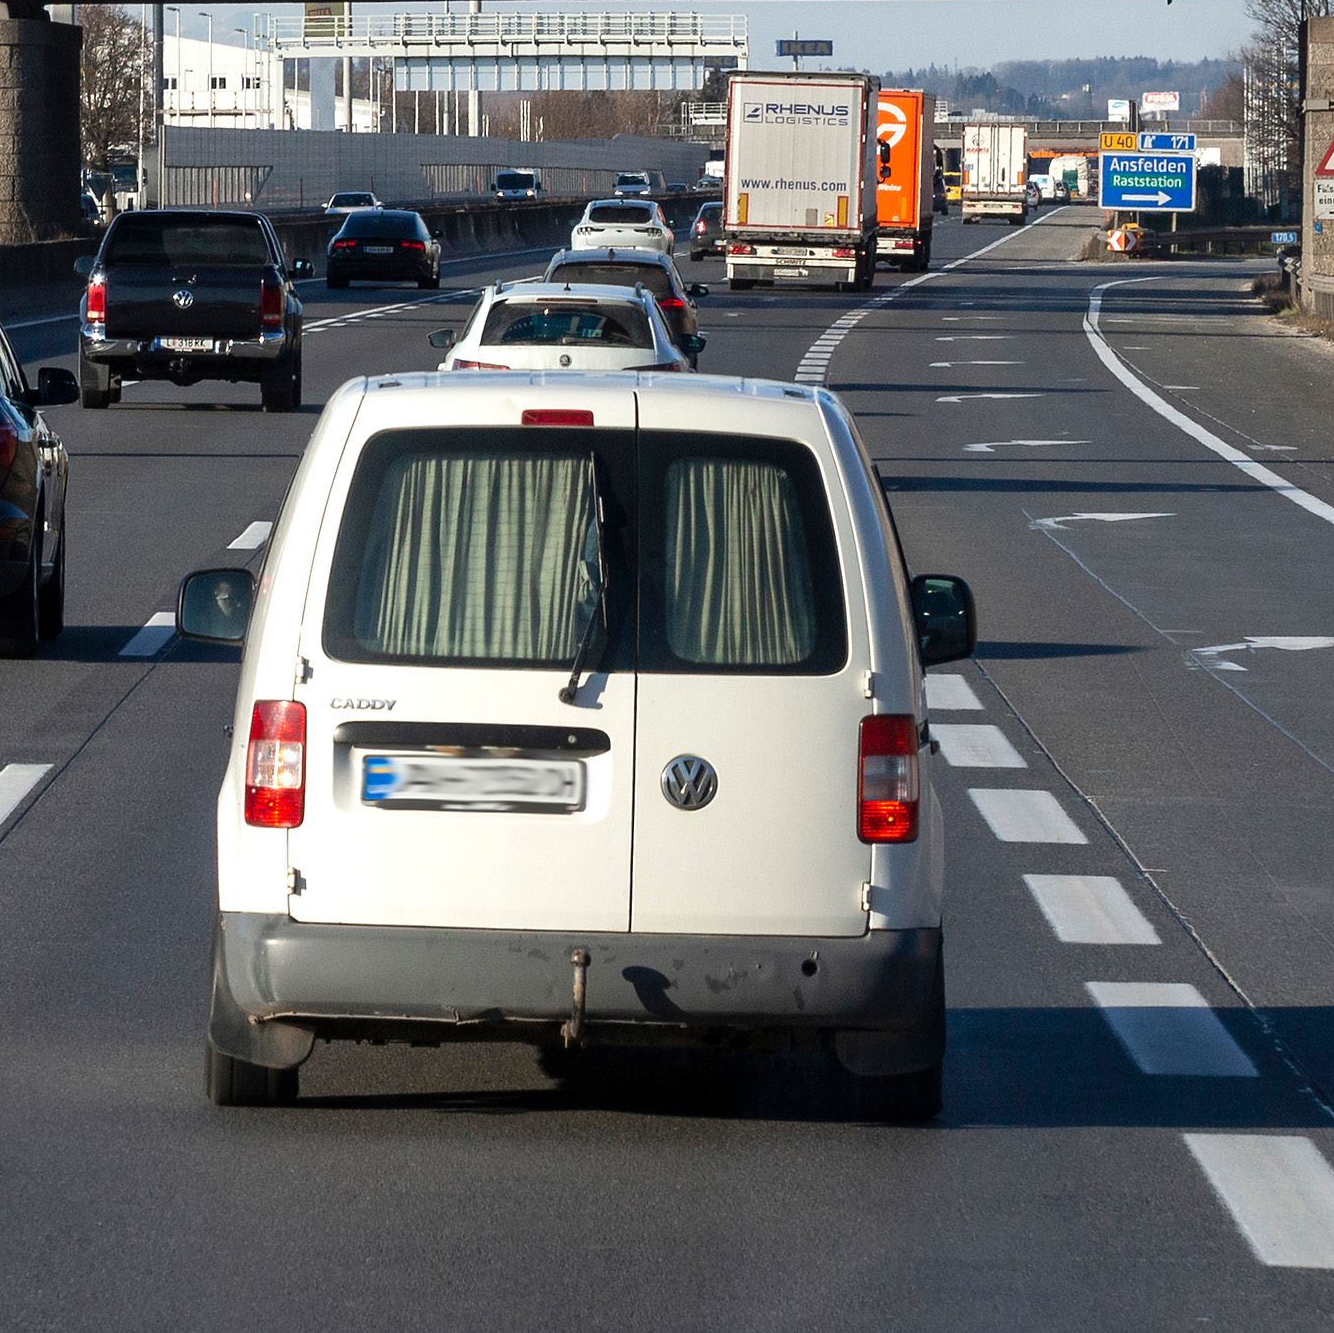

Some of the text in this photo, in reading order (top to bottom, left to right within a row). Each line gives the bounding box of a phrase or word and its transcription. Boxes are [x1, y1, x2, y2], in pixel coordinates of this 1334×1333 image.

[765, 103, 849, 117] RHENUS
[765, 116, 848, 127] LOGISTICS
[1104, 135, 1133, 149] U 40
[1170, 136, 1190, 149] 171
[1109, 157, 1187, 173] Ansfelden
[741, 178, 847, 192] www.rhenus.com
[1112, 174, 1182, 188] Raststation
[330, 698, 397, 711] CADDY
